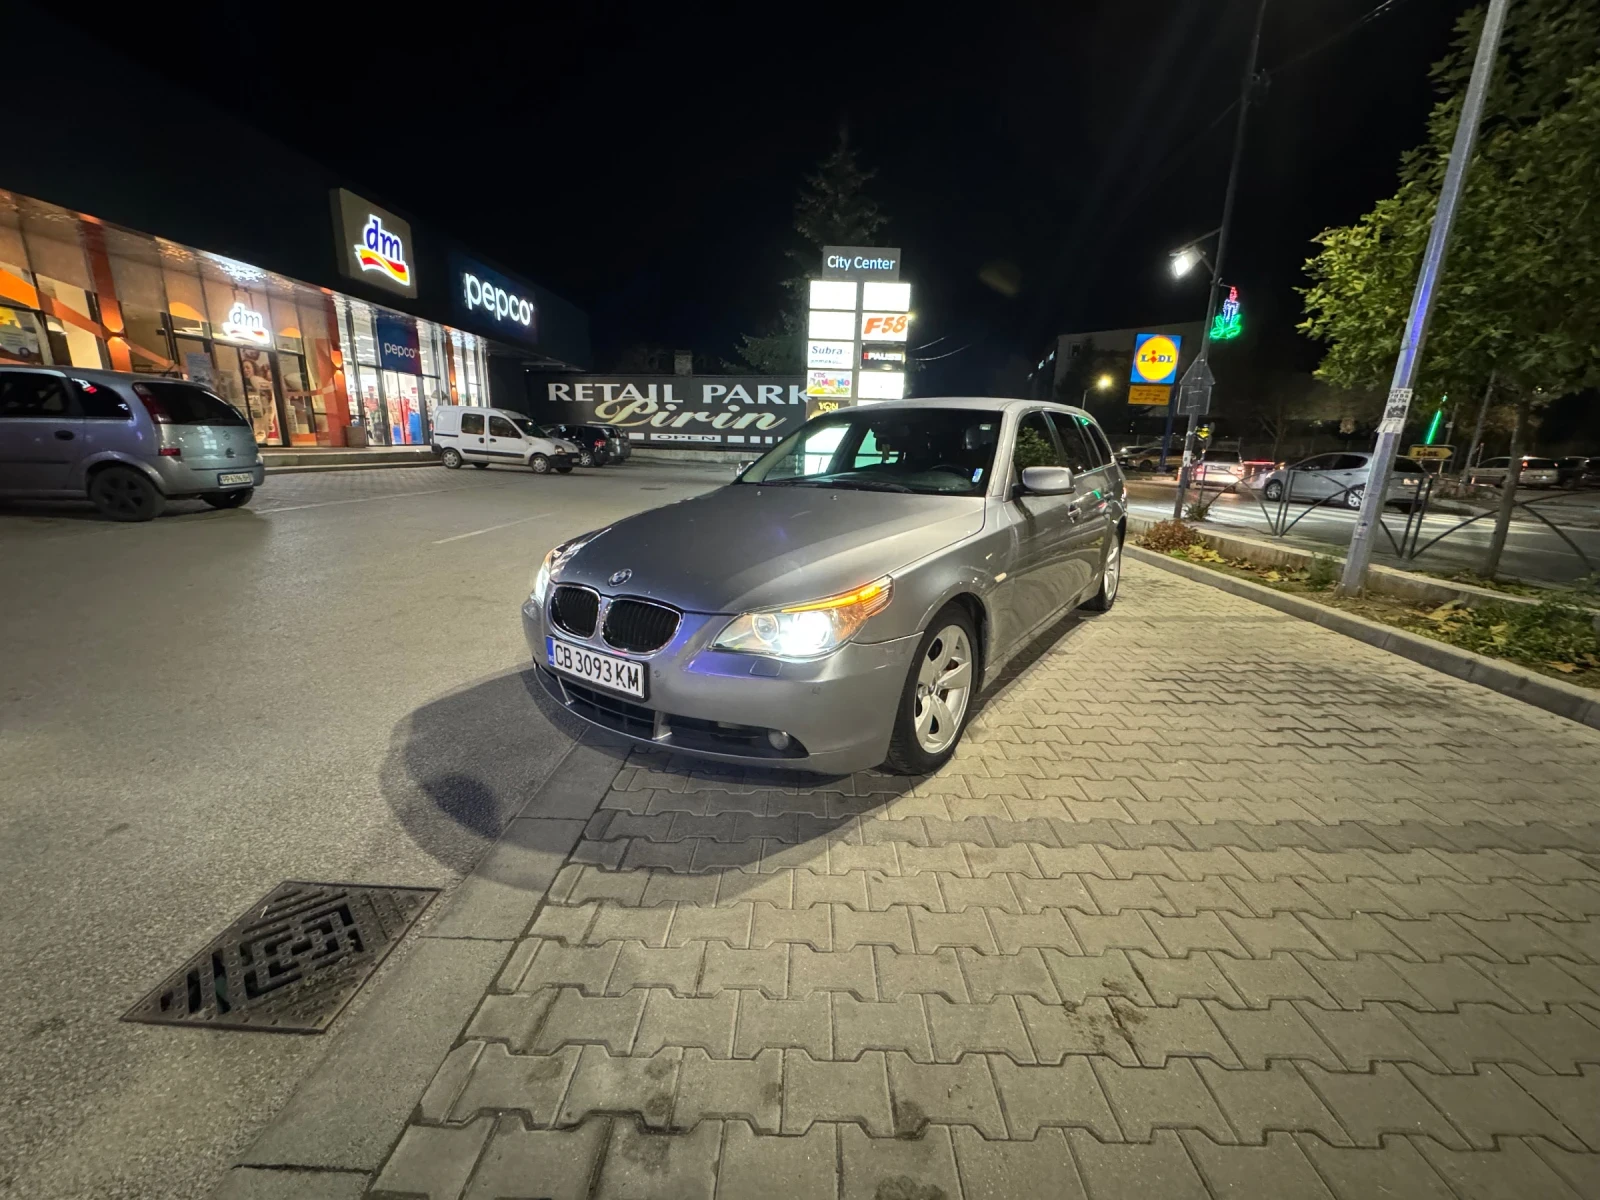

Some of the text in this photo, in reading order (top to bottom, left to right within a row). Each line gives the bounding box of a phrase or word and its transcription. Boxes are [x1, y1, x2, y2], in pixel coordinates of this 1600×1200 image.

[365, 218, 401, 262] dm
[827, 255, 896, 271] City Center
[464, 272, 532, 326] pepco
[232, 305, 260, 329] dm
[863, 315, 907, 335] F58
[383, 342, 416, 358] pepco
[811, 345, 843, 355] Subra
[547, 382, 812, 405] RETAIL PARK
[587, 398, 787, 431] Pirin
[555, 644, 573, 669] CB
[575, 651, 612, 683] 3093
[615, 663, 639, 691] KM
